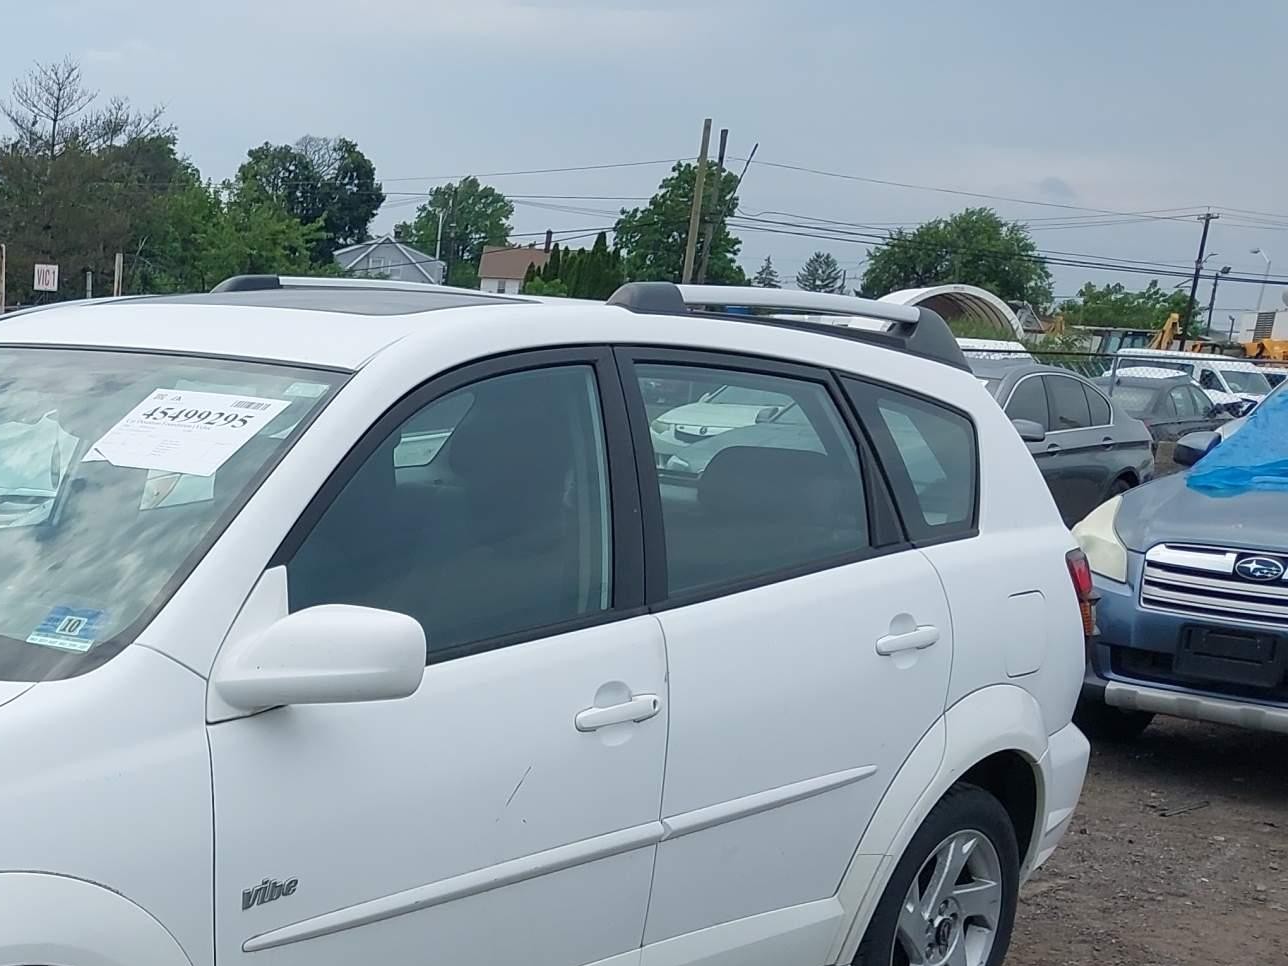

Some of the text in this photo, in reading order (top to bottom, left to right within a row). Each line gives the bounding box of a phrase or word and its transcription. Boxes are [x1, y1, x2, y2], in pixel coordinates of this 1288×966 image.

[37, 268, 50, 287] VIC
[142, 406, 255, 429] 45499295
[59, 618, 82, 633] 10
[241, 879, 298, 911] vibe
